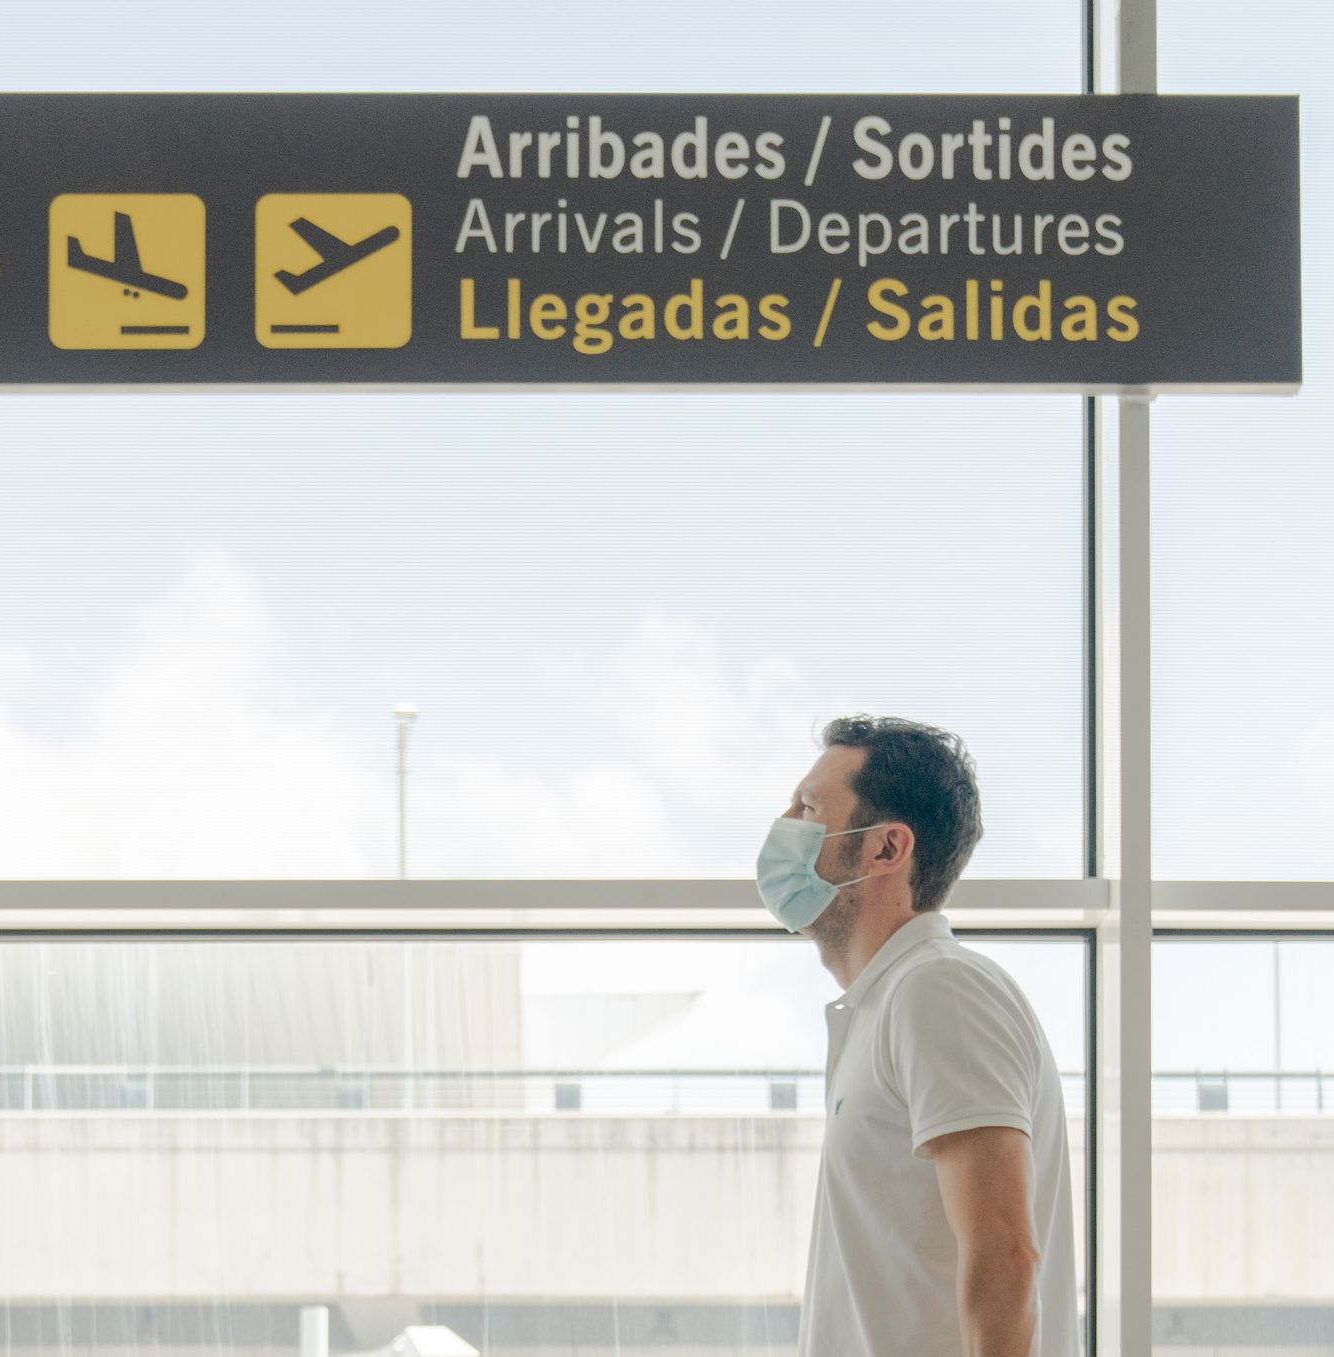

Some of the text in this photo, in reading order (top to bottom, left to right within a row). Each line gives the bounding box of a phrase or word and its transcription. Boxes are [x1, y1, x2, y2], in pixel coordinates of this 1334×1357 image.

[456, 114, 1134, 187] Arribades / Sortides
[455, 197, 1125, 268] Arrivals / Departures
[459, 277, 1141, 356] Llegadas / Salidas
